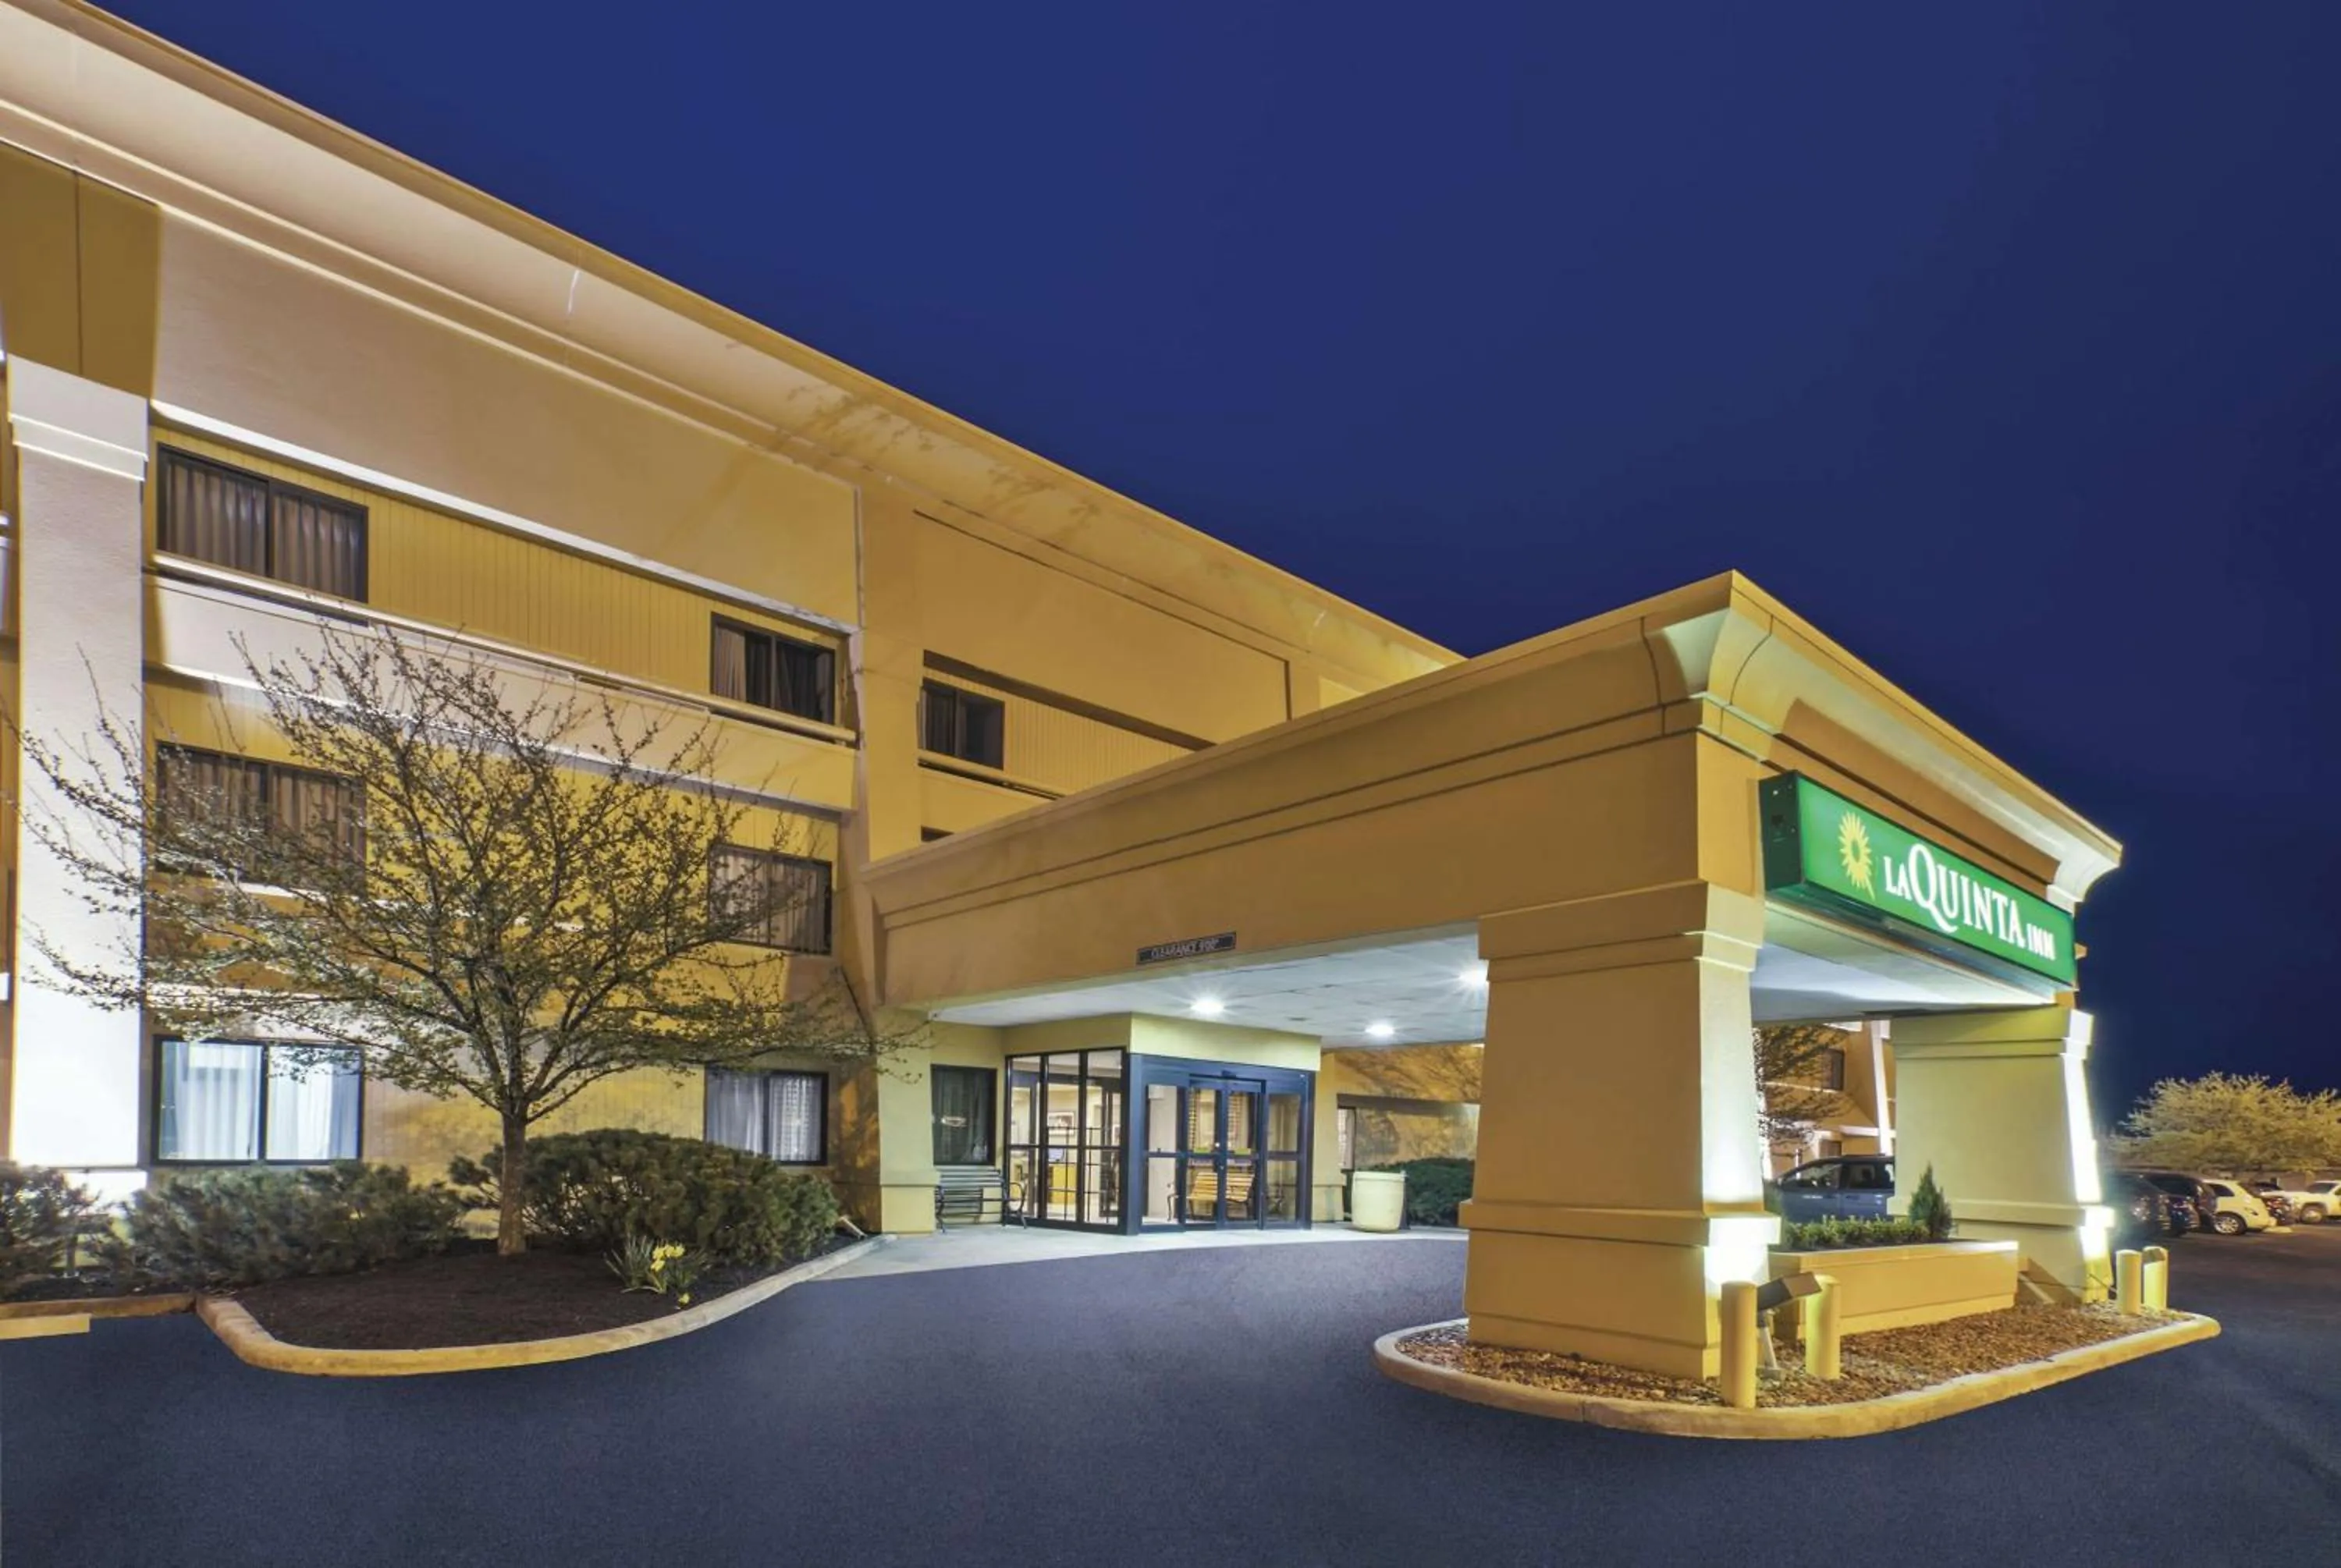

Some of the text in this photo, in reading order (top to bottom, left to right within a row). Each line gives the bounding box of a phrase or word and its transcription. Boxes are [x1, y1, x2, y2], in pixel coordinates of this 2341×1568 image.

[1883, 843, 2056, 960] LA QUINTA INN
[1151, 941, 1198, 960] CLEARANCE
